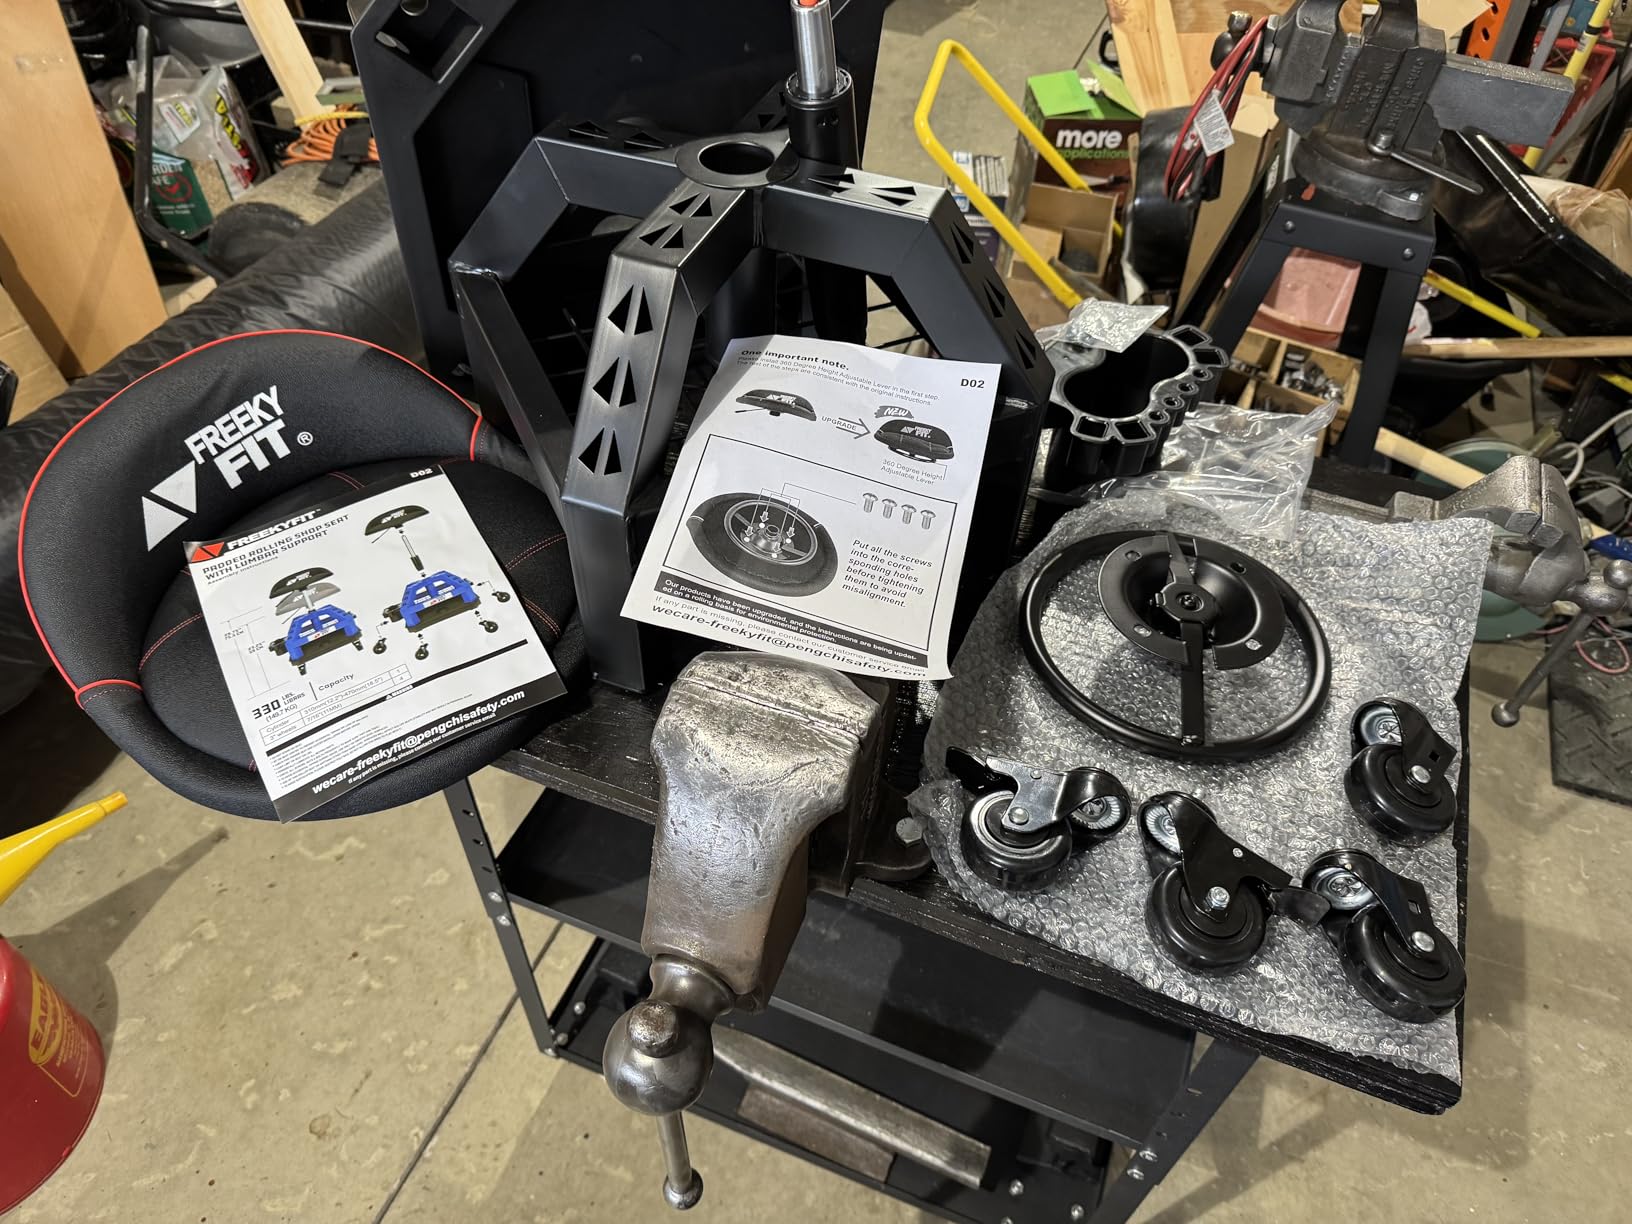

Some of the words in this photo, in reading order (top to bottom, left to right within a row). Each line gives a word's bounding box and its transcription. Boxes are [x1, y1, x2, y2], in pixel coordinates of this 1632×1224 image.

[1055, 129, 1123, 149] more
[765, 350, 819, 363] important
[821, 358, 849, 371] note.
[793, 362, 817, 370] Degree
[817, 366, 839, 376] Height
[839, 372, 872, 385] Adjustable
[873, 381, 892, 390] Lever
[899, 387, 910, 395] the
[911, 389, 923, 398] first
[924, 393, 940, 401] step.
[812, 370, 845, 384] consistent
[845, 380, 858, 388] with
[859, 383, 870, 391] the
[870, 387, 895, 398] original
[894, 392, 933, 406] instructions.
[960, 377, 985, 389] D02
[184, 385, 284, 465] FREEKY
[821, 415, 857, 431] UPGRADE
[883, 407, 909, 417] NEW
[213, 418, 292, 490] FIT
[409, 467, 433, 478] D02
[880, 465, 915, 481] Adjustable
[915, 475, 935, 486] Lever
[882, 459, 896, 468] 360
[896, 462, 920, 475] Degree
[921, 470, 943, 481] Height
[202, 553, 247, 575] PADDED
[248, 535, 293, 558] ROLLING
[294, 524, 323, 540] SHOP
[324, 513, 350, 529] SEAT
[205, 565, 233, 581] WITH
[234, 548, 279, 570] LUMBAR
[280, 529, 329, 552] SUPPORT
[852, 539, 870, 550] Put
[870, 545, 883, 554] all
[883, 549, 898, 559] the
[899, 554, 933, 568] screws
[848, 557, 892, 577] sponding
[893, 569, 919, 583] holes
[850, 548, 869, 559] into
[870, 554, 885, 564] the
[887, 560, 915, 572] corre-
[844, 574, 868, 587] them
[869, 582, 879, 590] to
[880, 585, 908, 598] avoid
[846, 565, 876, 580] before
[877, 575, 925, 596] tightening
[841, 583, 906, 608] misalignment.
[664, 579, 679, 588] Our
[679, 584, 712, 599] products
[712, 594, 731, 605] have
[731, 600, 751, 611] been
[752, 607, 788, 623] upgraded,
[789, 619, 804, 627] and
[804, 622, 817, 631] the
[817, 626, 859, 644] instructions
[859, 639, 872, 648] are
[873, 643, 893, 655] being
[894, 650, 917, 660] updat-
[673, 589, 684, 597] on
[691, 594, 714, 607] rolling
[714, 601, 735, 612] basis
[735, 607, 746, 616] for
[747, 611, 799, 632] environmental
[799, 627, 837, 643] protection.
[652, 604, 927, 678] wecare-freekyfit@pengchisafety.com
[663, 598, 681, 607] any
[680, 602, 700, 612] part
[700, 607, 708, 615] is
[747, 622, 776, 635] please
[778, 631, 810, 645] contact
[811, 640, 826, 649] our
[826, 645, 867, 661] customer
[868, 656, 900, 669] service
[901, 664, 925, 673] email
[318, 673, 355, 692] Capacity
[251, 699, 281, 720] 330
[281, 691, 295, 701] LBS.
[265, 709, 284, 723] (149.7
[284, 703, 298, 714] KG)
[266, 719, 289, 733] Cylinder
[277, 725, 297, 738] wheels
[311, 689, 526, 795] wecare-freekyfit@pengchisafety.com
[353, 772, 363, 782] any
[362, 767, 373, 777] part
[398, 747, 415, 760] please
[414, 739, 434, 752] contact
[432, 735, 442, 743] our
[441, 725, 465, 739] customer
[464, 718, 482, 729] service
[481, 712, 497, 722] email
